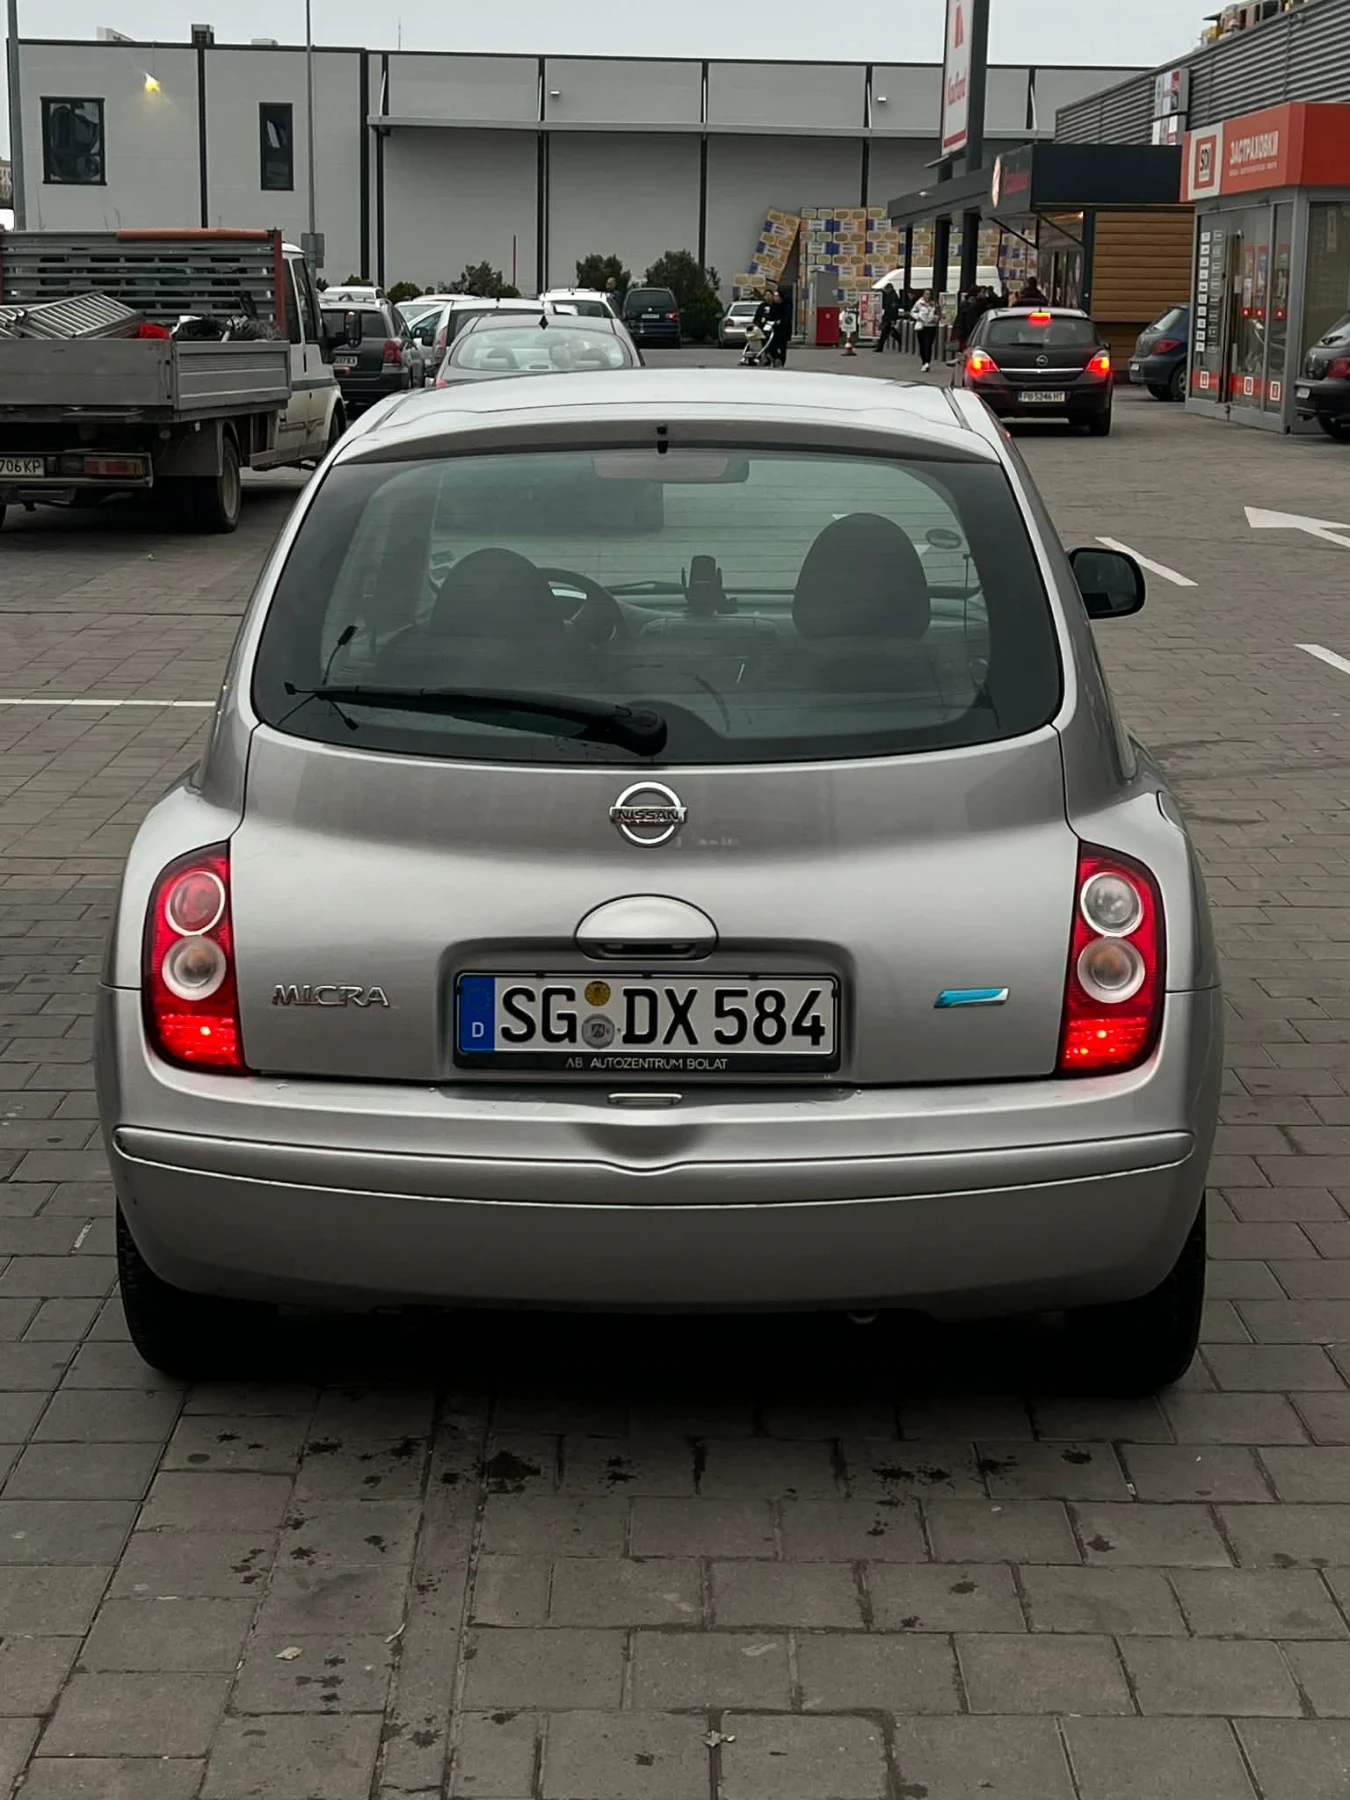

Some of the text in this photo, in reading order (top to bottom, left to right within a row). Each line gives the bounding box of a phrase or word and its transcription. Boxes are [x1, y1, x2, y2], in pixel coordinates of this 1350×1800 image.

[24, 459, 41, 474] KP
[618, 808, 680, 821] NISSAN
[272, 984, 390, 1008] MICRA
[500, 986, 826, 1046] SG DX 584
[471, 1022, 485, 1038] D
[590, 1057, 683, 1070] AUTOZENTRUM
[686, 1058, 729, 1070] BOLAT
